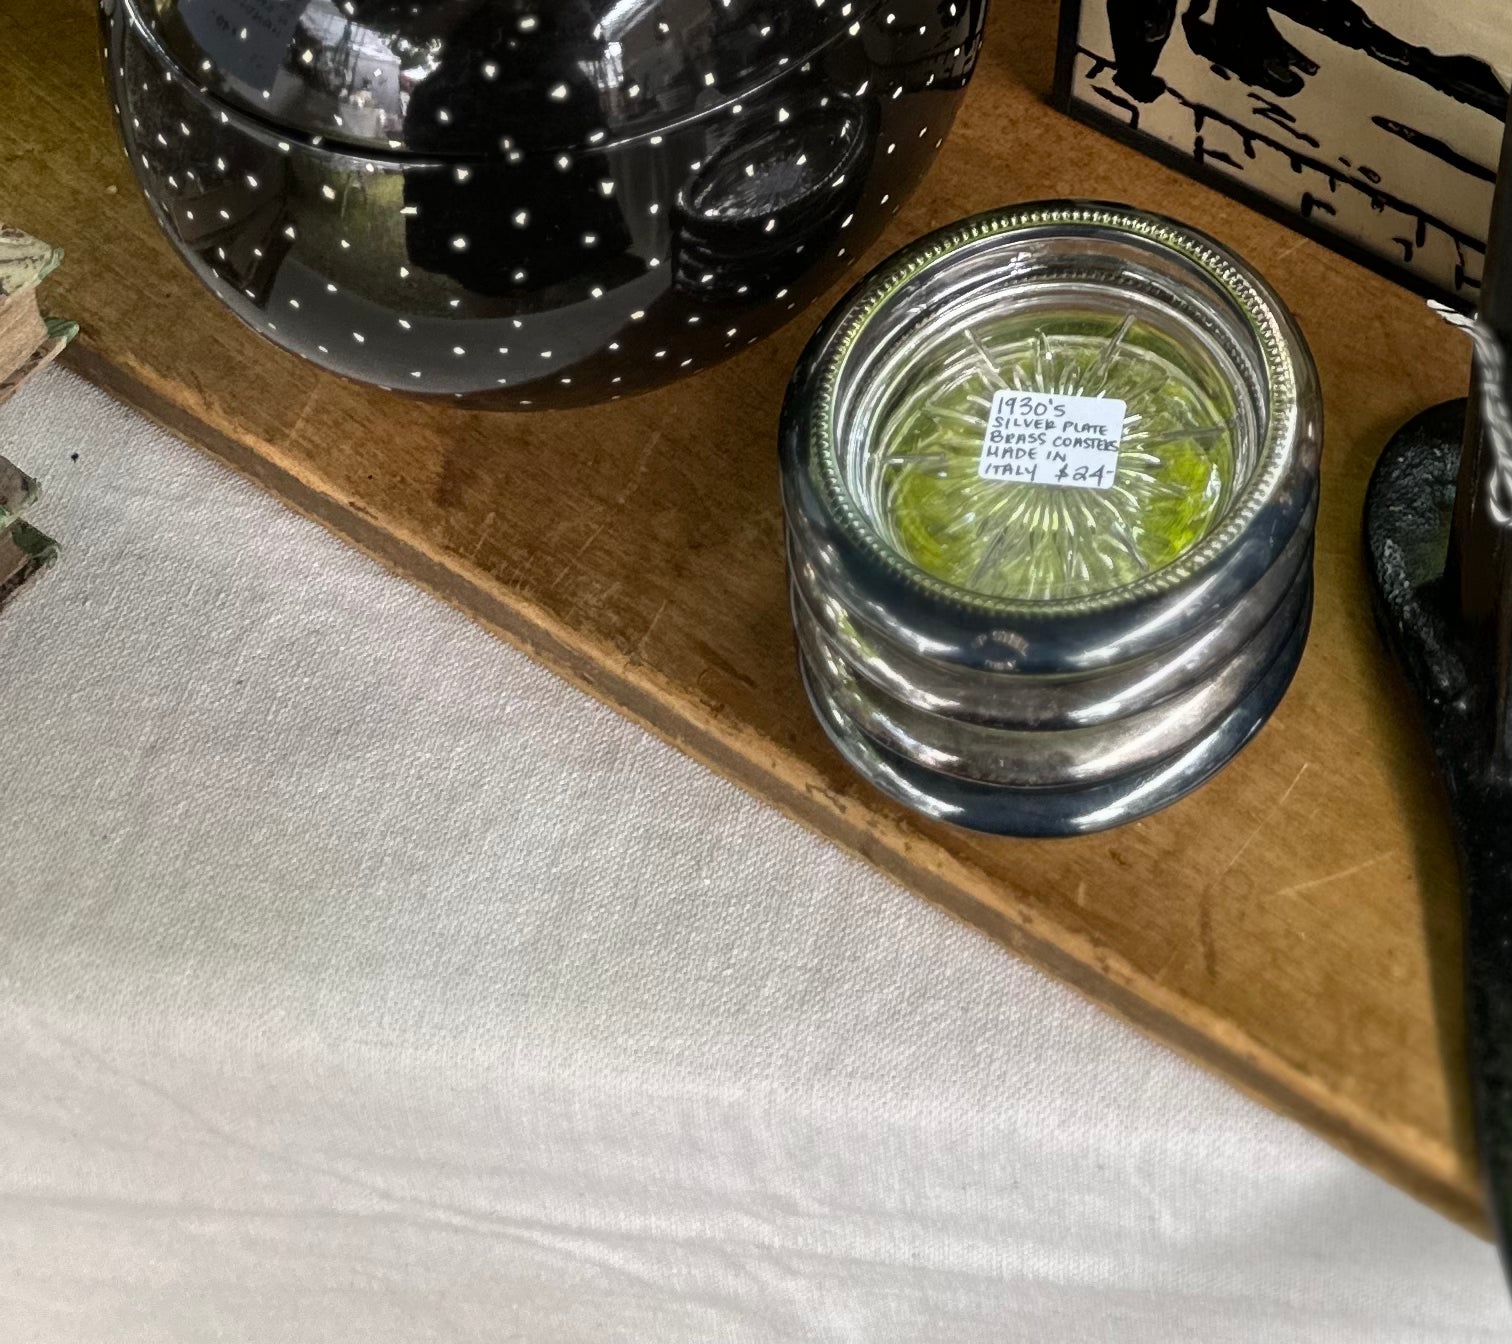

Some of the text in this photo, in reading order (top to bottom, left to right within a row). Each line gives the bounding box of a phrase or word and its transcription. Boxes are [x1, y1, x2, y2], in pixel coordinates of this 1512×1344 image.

[992, 417, 1109, 436] SILVER PLATE
[989, 430, 1120, 452] BRASS COASTERS
[986, 446, 1067, 462] MADE IN
[984, 463, 1037, 481] ITALY
